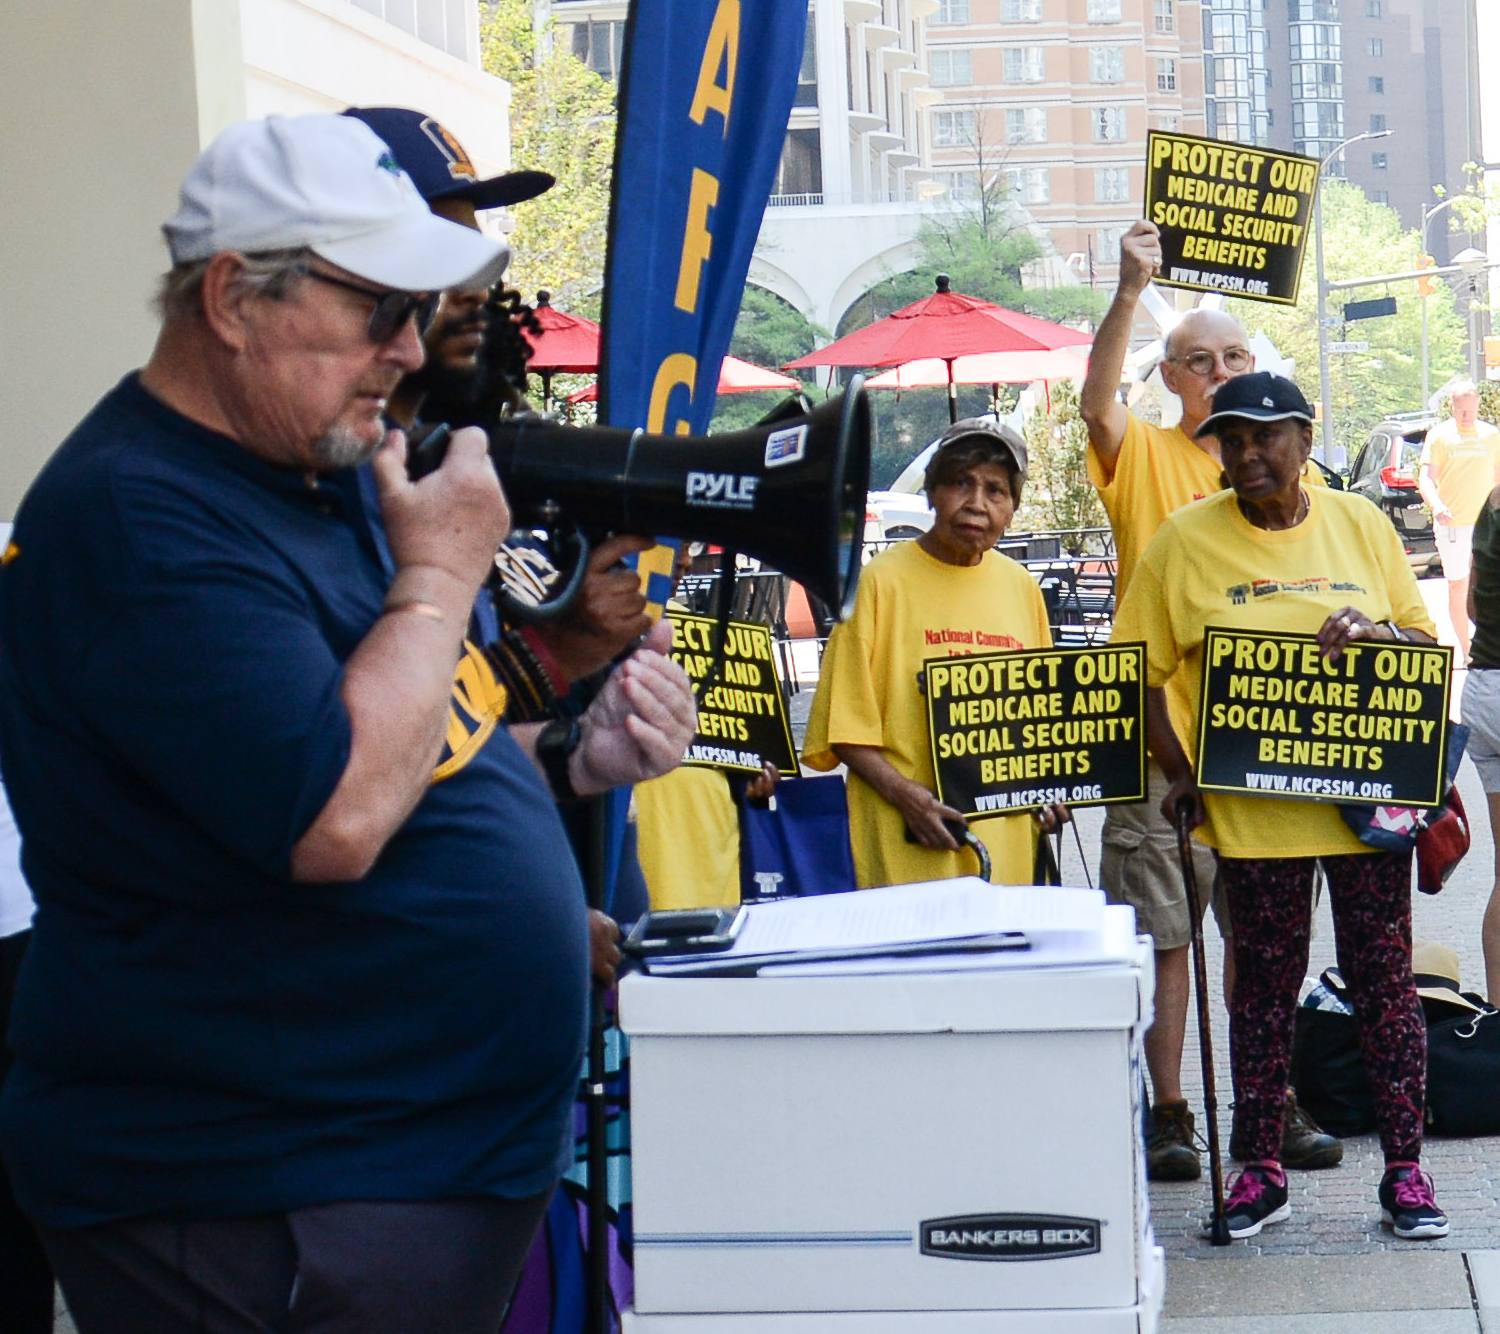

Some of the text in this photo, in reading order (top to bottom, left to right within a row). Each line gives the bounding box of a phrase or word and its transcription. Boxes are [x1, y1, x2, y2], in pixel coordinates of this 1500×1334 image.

[1153, 139, 1315, 194] PROTECT OUR
[1167, 175, 1299, 219] MEDICARE AND
[1153, 201, 1303, 247] SOCIAL SECURITY
[1182, 235, 1267, 270] BENEFITS
[1169, 267, 1269, 296] WWW.NCPSSM.ORG
[925, 629, 974, 645] National
[725, 660, 762, 687] AND
[931, 652, 1138, 698] PROTECT OUR
[1374, 649, 1444, 685] OUR
[693, 683, 775, 716] ECURITY
[950, 689, 1122, 727] MEDICARE AND
[1229, 674, 1423, 713] MEDICARE AND
[696, 711, 749, 742] EFITS
[938, 717, 1134, 758] SOCIAL SECURITY
[1211, 703, 1436, 744] SOCIAL SECURITY
[980, 750, 1091, 784] BENEFITS
[1258, 737, 1384, 771] BENEFITS
[974, 784, 1102, 811] WWW.NCPSSM.ORG
[1245, 772, 1393, 799] WWW.NCPSSM.ORG
[930, 1229, 1092, 1246] BANKERS BOX
